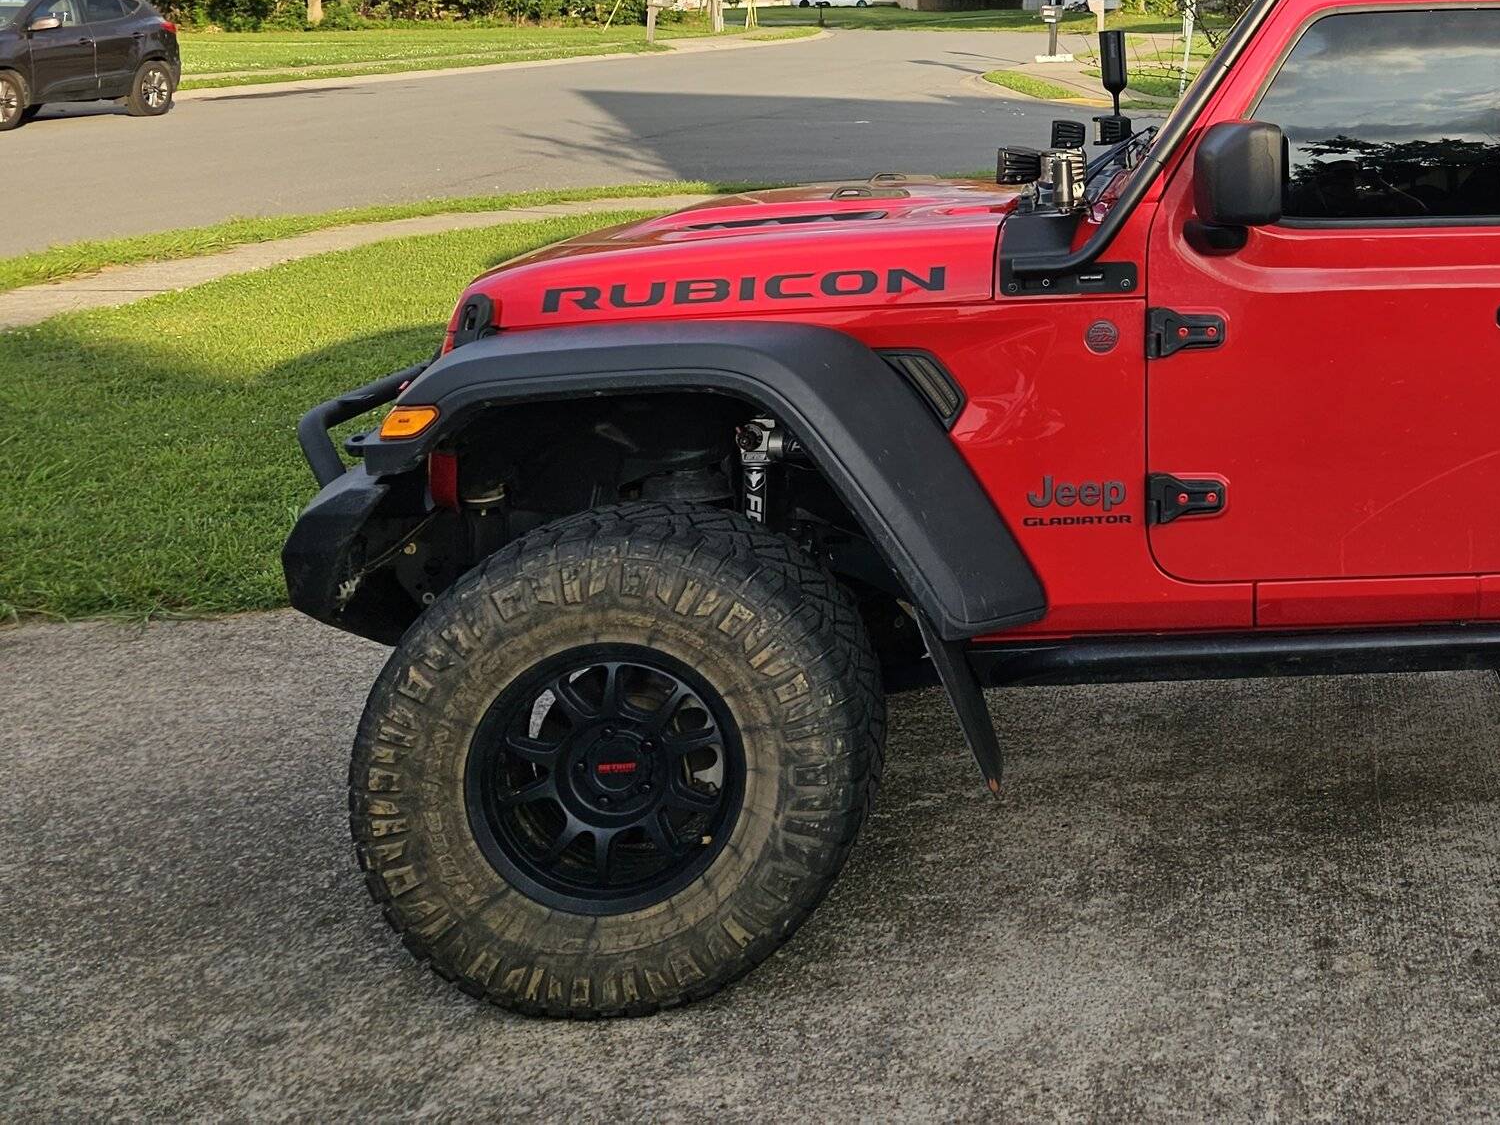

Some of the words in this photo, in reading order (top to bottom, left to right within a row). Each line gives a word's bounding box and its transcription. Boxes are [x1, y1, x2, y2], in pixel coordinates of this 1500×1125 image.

[541, 266, 946, 313] RUBICON
[1027, 475, 1126, 511] Jeep
[1023, 515, 1132, 526] GLADIATOR
